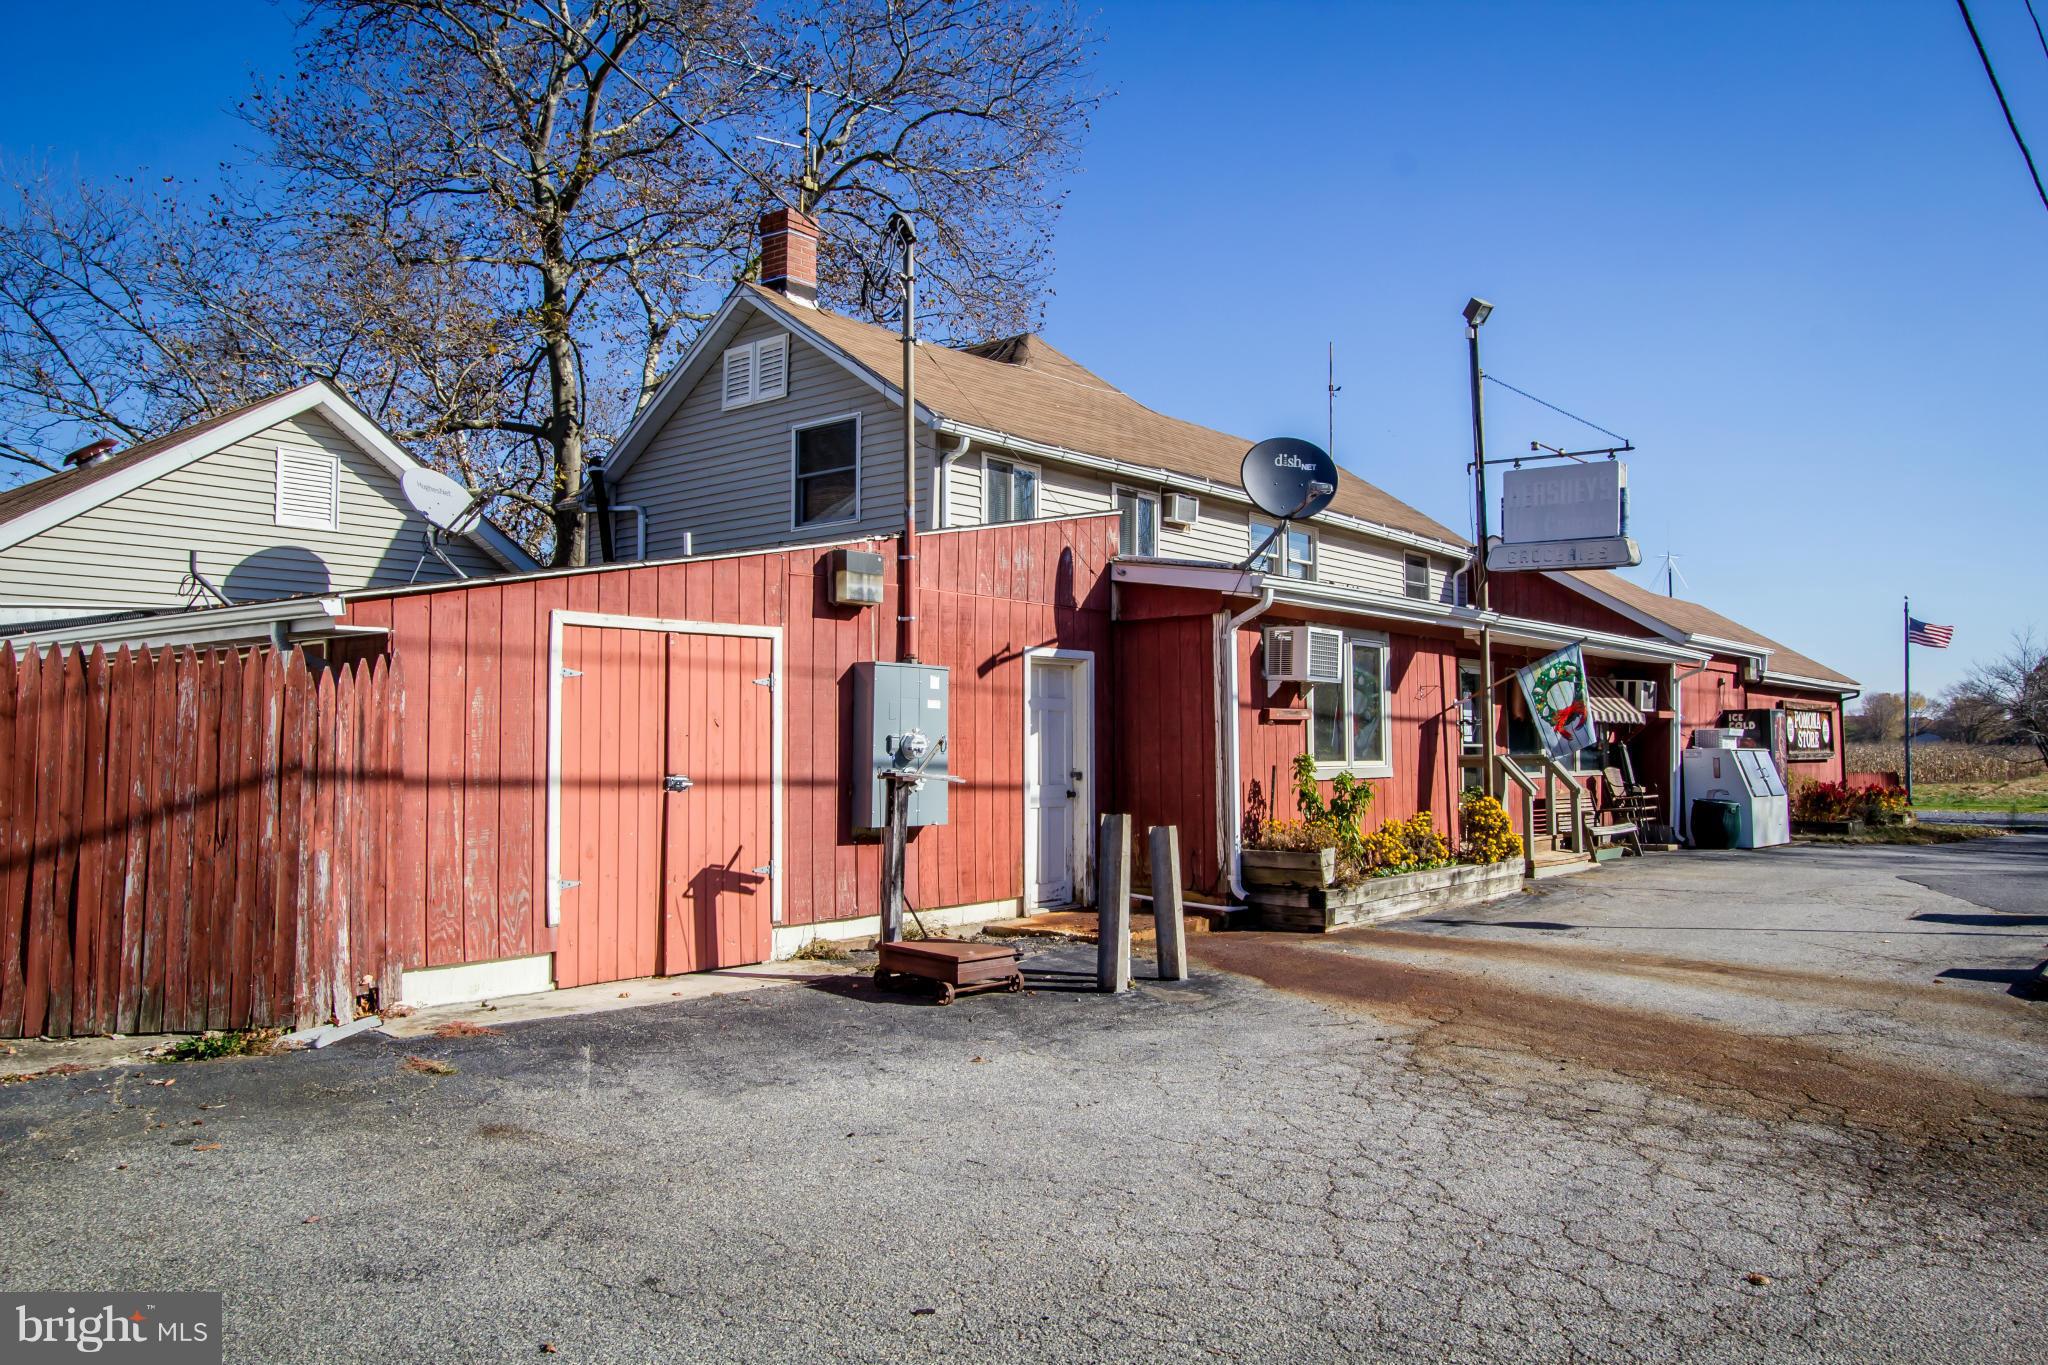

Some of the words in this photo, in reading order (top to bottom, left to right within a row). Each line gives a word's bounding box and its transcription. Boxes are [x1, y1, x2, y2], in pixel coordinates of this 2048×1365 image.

[1274, 453, 1302, 468] dish
[1301, 463, 1317, 471] NET
[1728, 713, 1744, 722] ICE
[1729, 721, 1756, 730] COLD
[1794, 711, 1821, 729] POMONA
[1797, 731, 1820, 748] STORE
